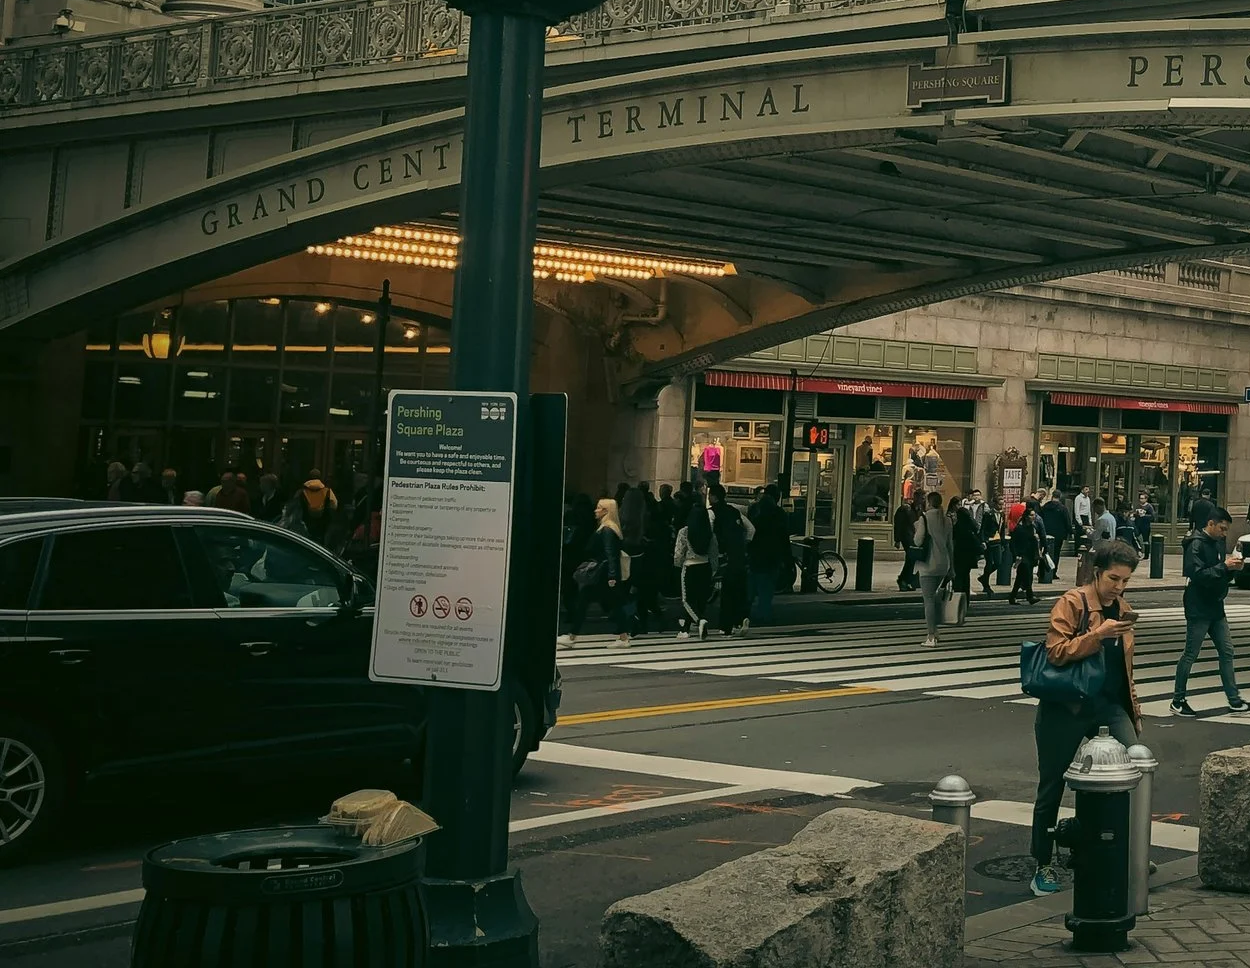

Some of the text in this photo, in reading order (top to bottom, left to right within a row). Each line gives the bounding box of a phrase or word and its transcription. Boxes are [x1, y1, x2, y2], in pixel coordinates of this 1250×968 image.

[912, 75, 1000, 90] PERSHING SQUARE
[201, 84, 809, 235] GRAND CENT TERMINAL
[838, 383, 882, 394] vineyard vines
[397, 406, 442, 420] Pershing
[481, 407, 506, 420] DOT
[397, 423, 464, 437] Square Plaza
